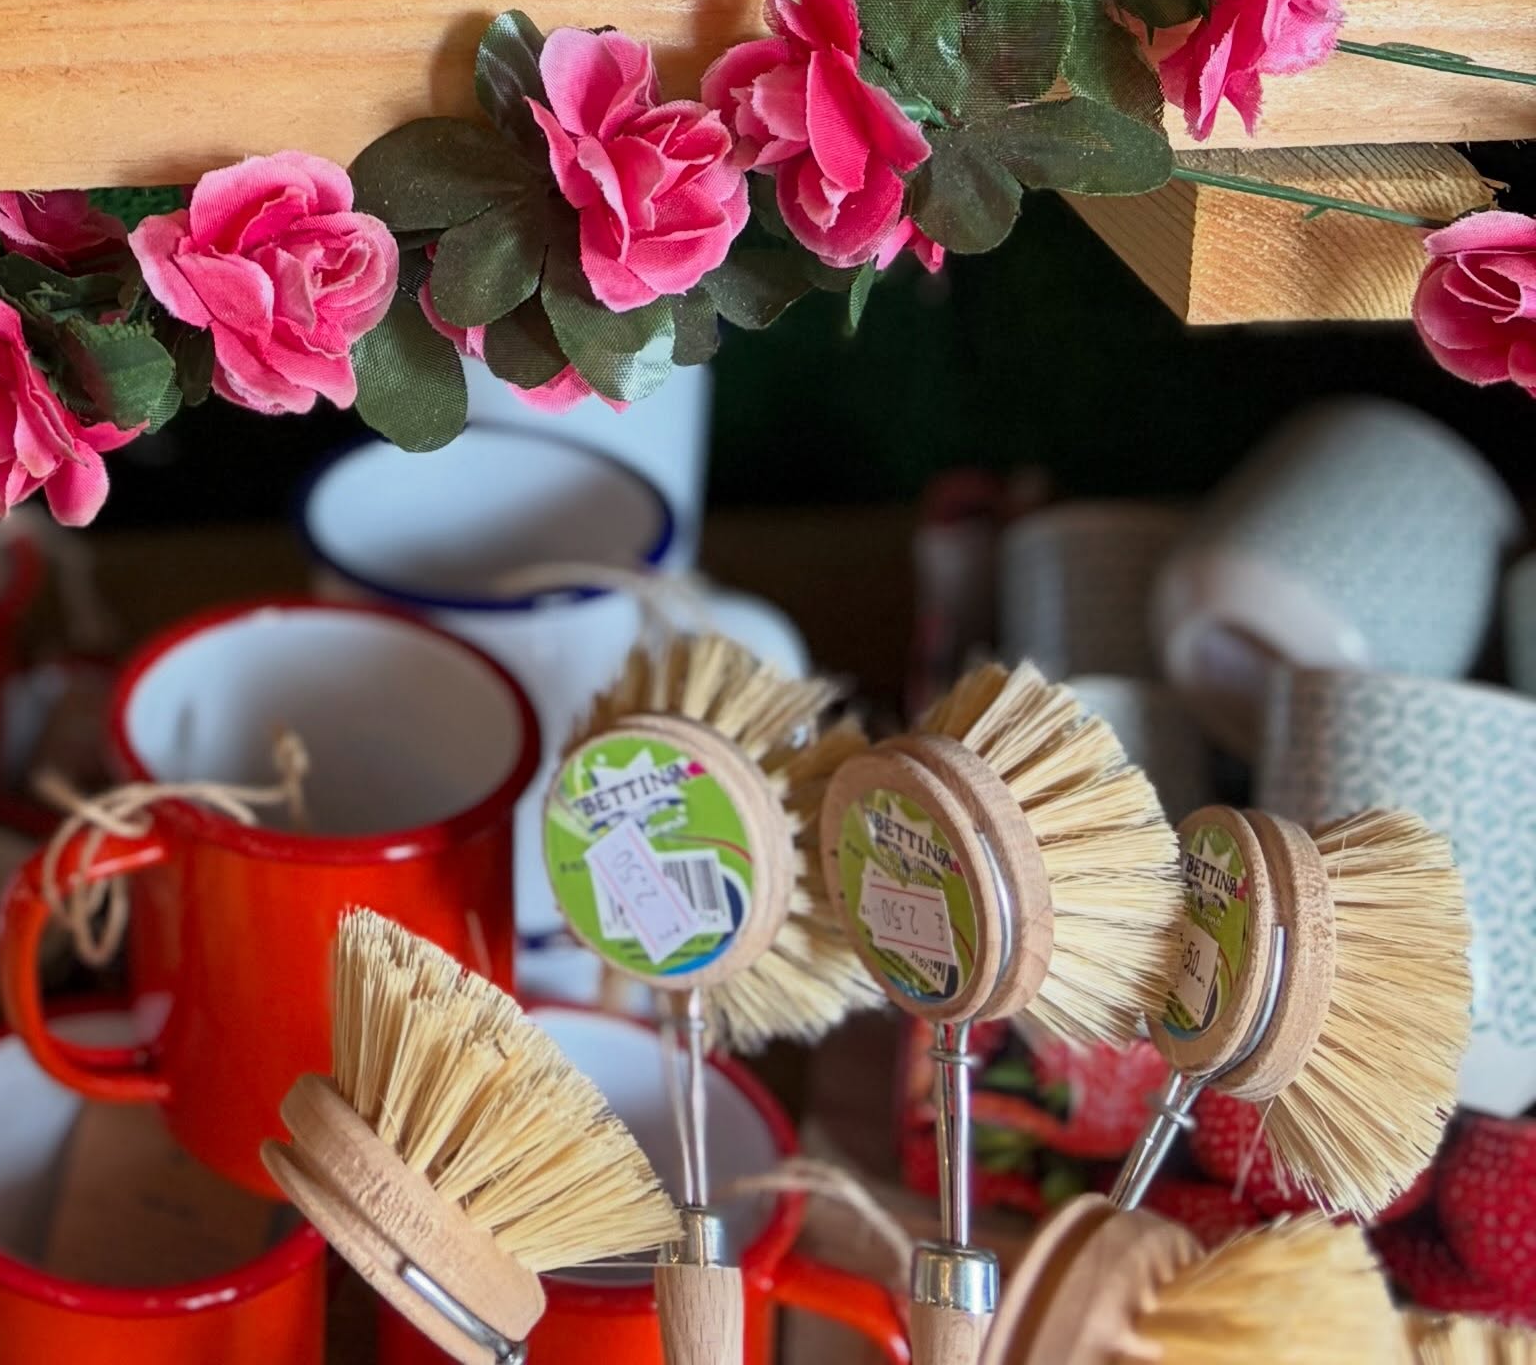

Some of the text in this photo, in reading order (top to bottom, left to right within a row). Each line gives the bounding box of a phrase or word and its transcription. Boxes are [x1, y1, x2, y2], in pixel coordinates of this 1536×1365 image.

[870, 810, 953, 868] BETTINA
[1185, 851, 1238, 898] BETTINA
[881, 898, 919, 936] 2.50
